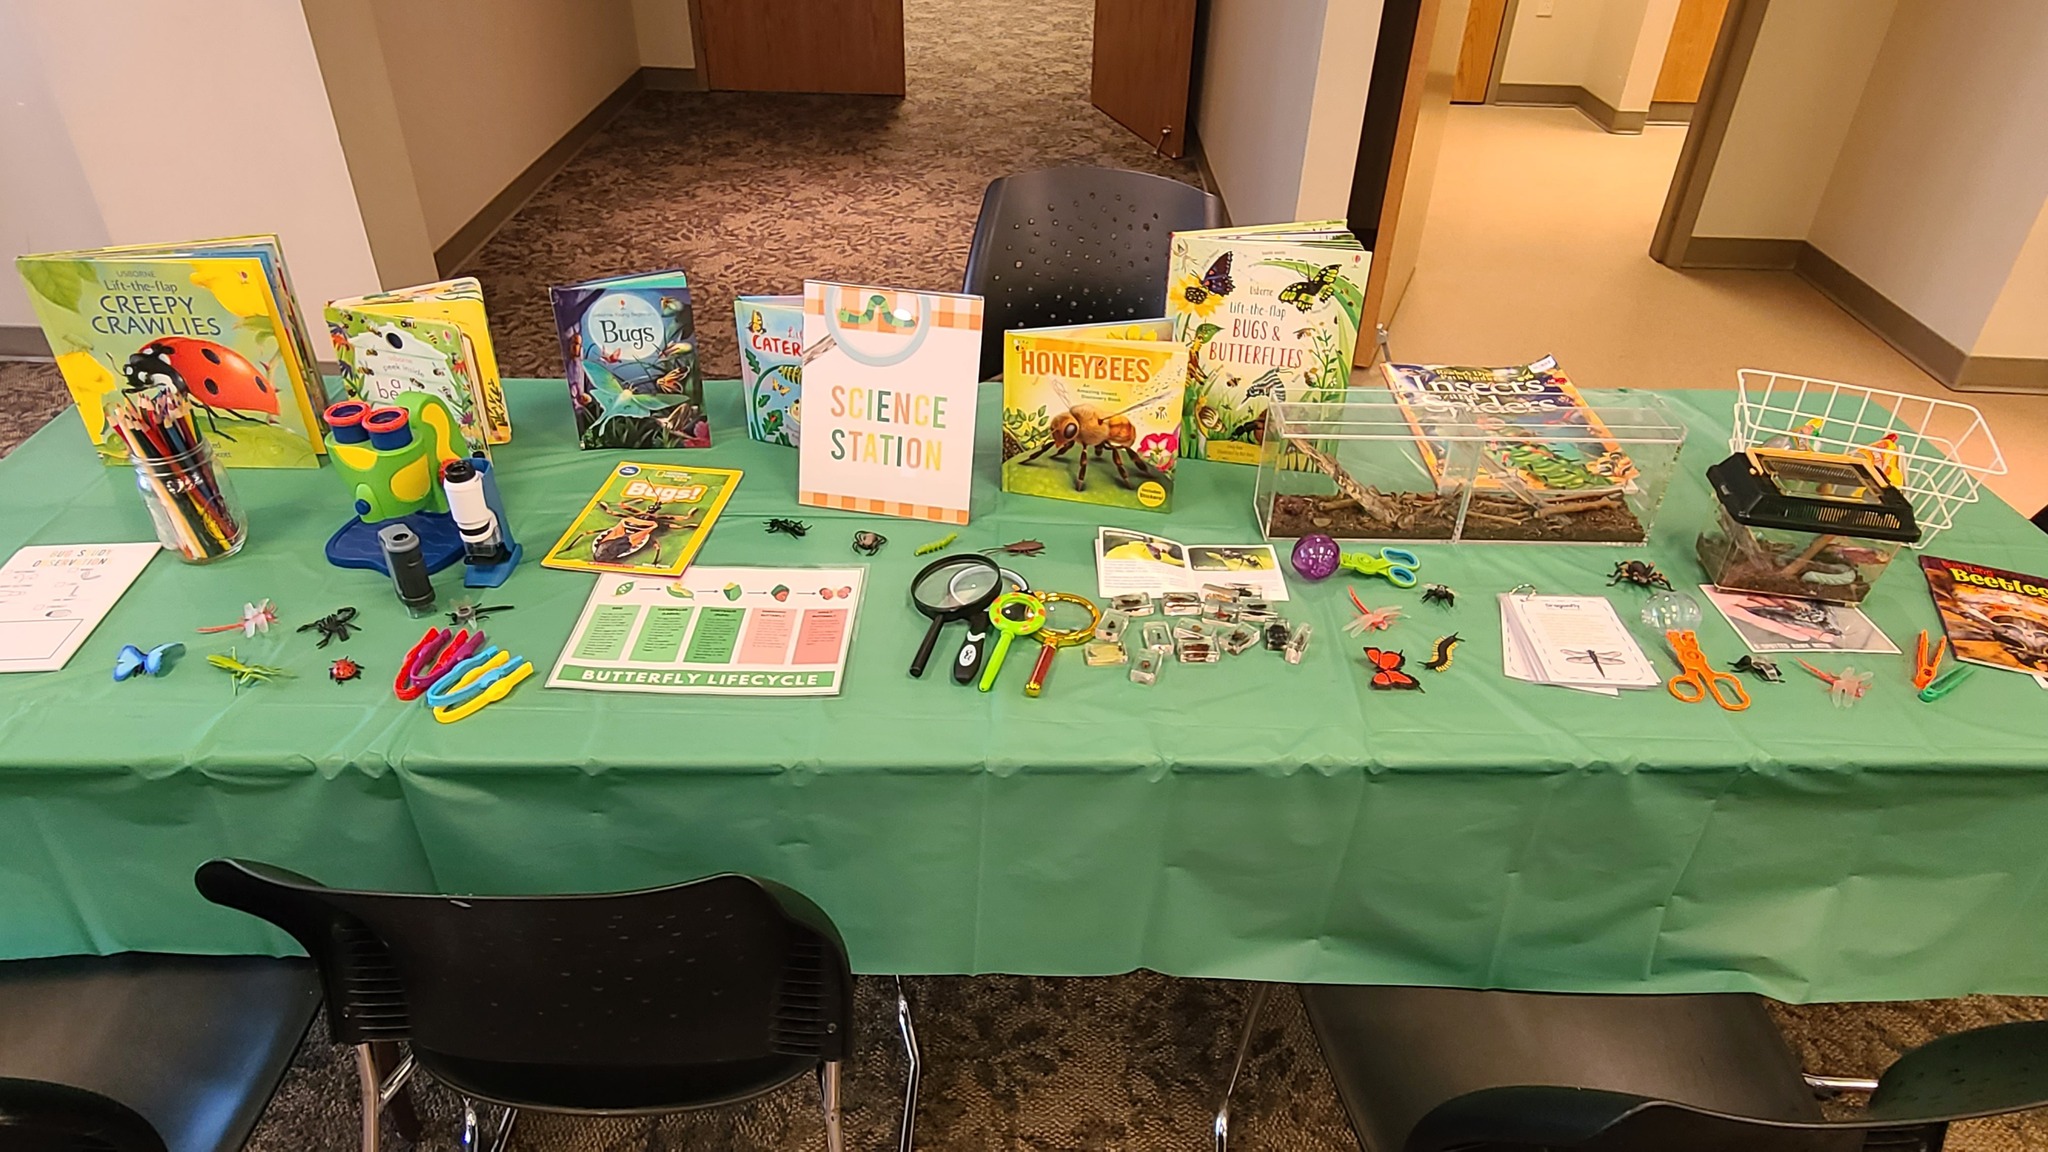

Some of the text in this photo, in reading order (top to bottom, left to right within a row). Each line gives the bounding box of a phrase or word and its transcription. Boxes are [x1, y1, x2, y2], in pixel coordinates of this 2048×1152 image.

[116, 270, 156, 278] USBORNE
[104, 279, 178, 294] Lift-the-flap
[1249, 285, 1274, 297] Usborne
[99, 295, 194, 315] CREEPY
[91, 316, 222, 336] CRAWLIES
[599, 319, 655, 350] Bugs
[1232, 318, 1281, 341] BUGS &
[1208, 341, 1303, 368] BUTTERFLIES
[1021, 350, 1151, 383] HONEYBEES
[390, 378, 401, 390] a
[1412, 374, 1546, 395] Insects
[830, 384, 949, 429] SCIENCE
[1420, 394, 1559, 419] Spiders
[1448, 391, 1480, 402] and
[830, 428, 943, 472] STATION
[626, 482, 703, 503] Bugs!
[1949, 567, 2048, 599] Beetles
[581, 669, 819, 686] BUTTERFLY LIFECYCLE
